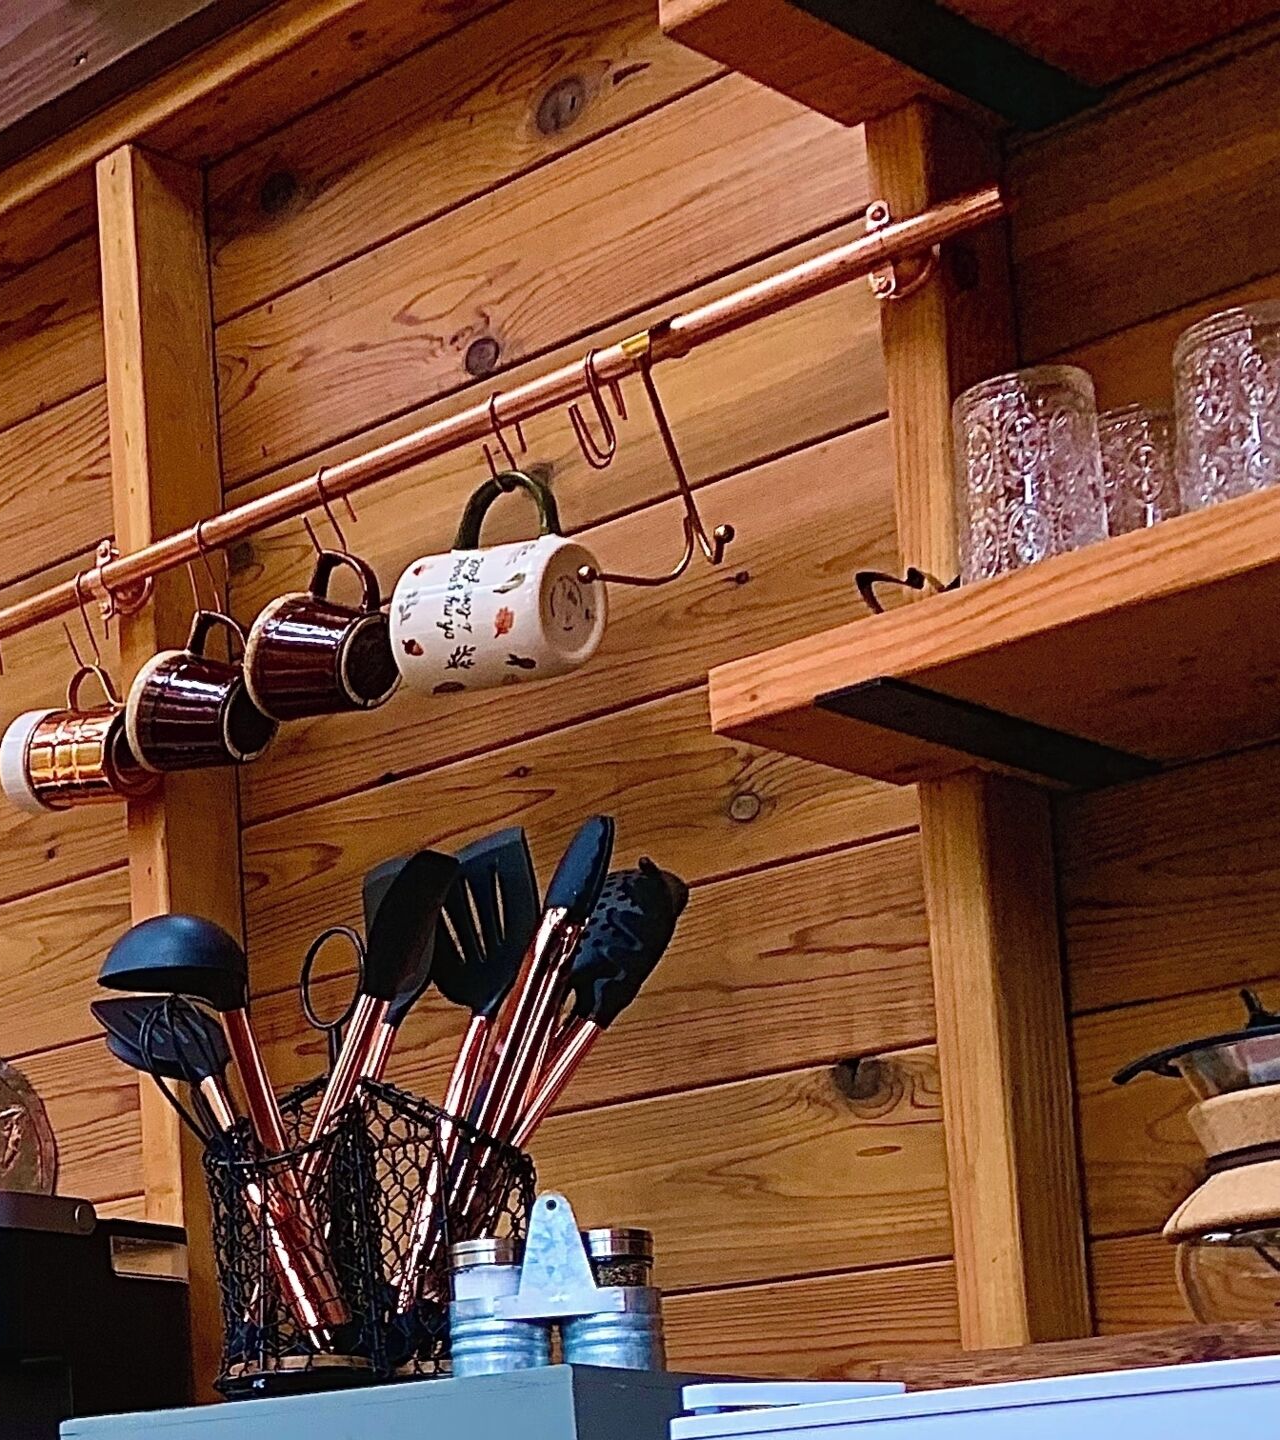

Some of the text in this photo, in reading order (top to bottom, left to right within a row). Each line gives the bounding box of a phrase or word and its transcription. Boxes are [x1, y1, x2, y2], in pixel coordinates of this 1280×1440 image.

[463, 557, 484, 583] fall
[444, 595, 460, 617] my
[456, 584, 472, 620] lov
[436, 619, 455, 640] oh
